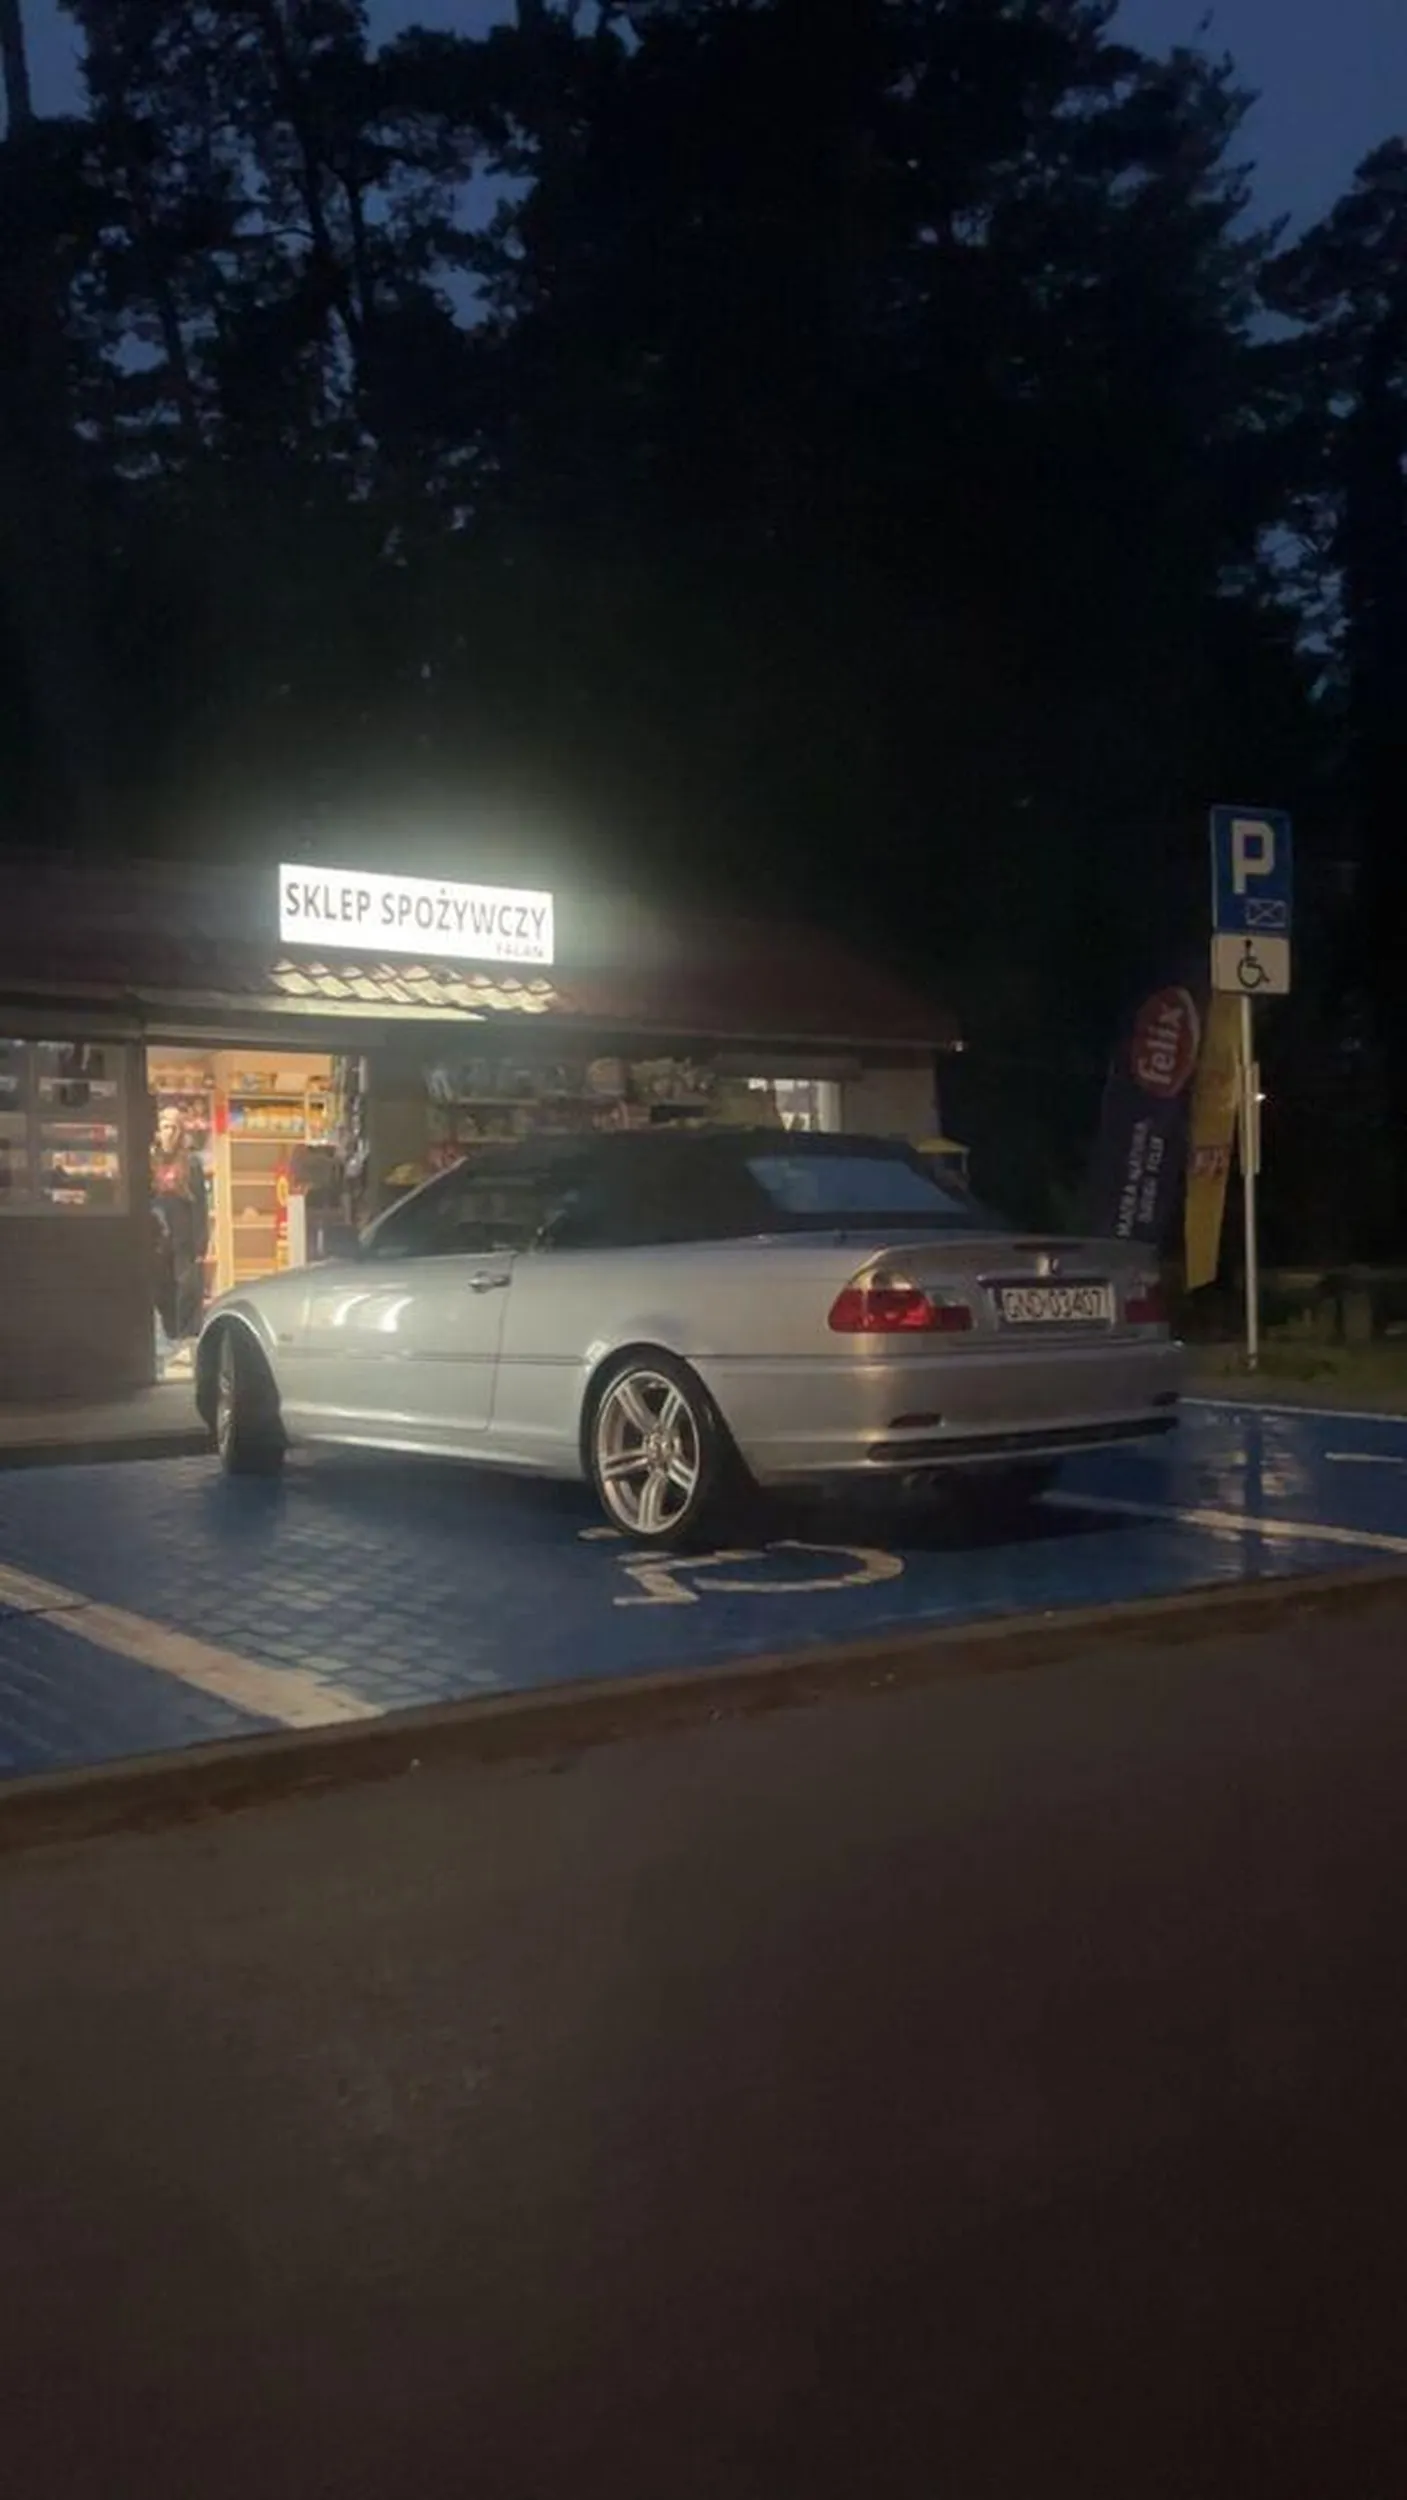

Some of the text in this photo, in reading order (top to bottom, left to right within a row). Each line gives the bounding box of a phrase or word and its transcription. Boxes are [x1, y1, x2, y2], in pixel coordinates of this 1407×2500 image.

[1231, 819, 1275, 894] P
[286, 882, 547, 940] SKLEP SPOŻYWCZY
[1138, 1003, 1184, 1085] felix
